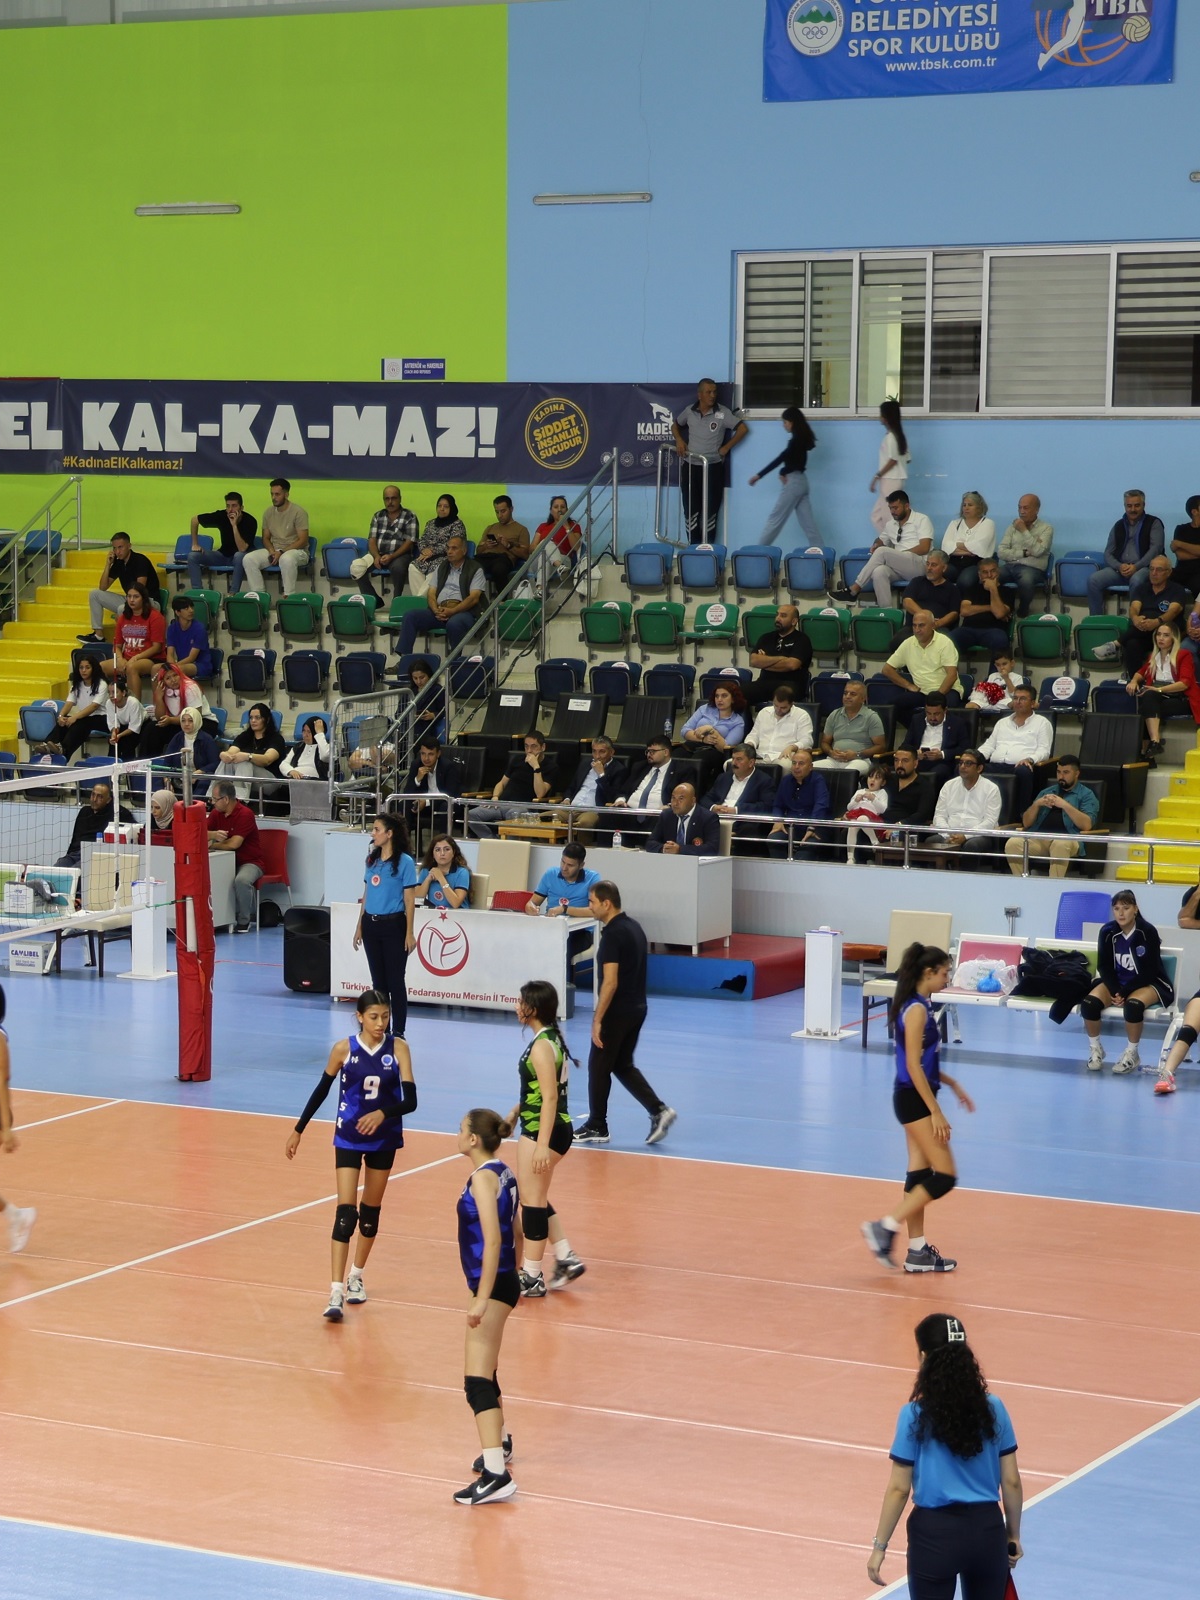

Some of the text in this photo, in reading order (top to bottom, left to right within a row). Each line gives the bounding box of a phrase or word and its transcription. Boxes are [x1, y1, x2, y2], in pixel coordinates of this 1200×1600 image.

[850, 0, 999, 33] BELEDİYESİ
[848, 27, 1000, 58] SPOR KULÜBÜ
[885, 56, 997, 72] www.tbsk.com.tr
[533, 403, 565, 422] KADINA
[81, 401, 499, 459] KAL-KA-MAZ!
[533, 413, 576, 442] ŞİDDET
[537, 425, 582, 451] İNSANLIK
[539, 436, 583, 460] SUÇUDUR
[63, 455, 183, 470] #KadınaElKalkamaz!
[341, 981, 371, 993] Türkiye
[408, 987, 462, 1000] Fedarasyonu
[462, 992, 492, 1002] Mersin
[363, 1075, 381, 1100] 9
